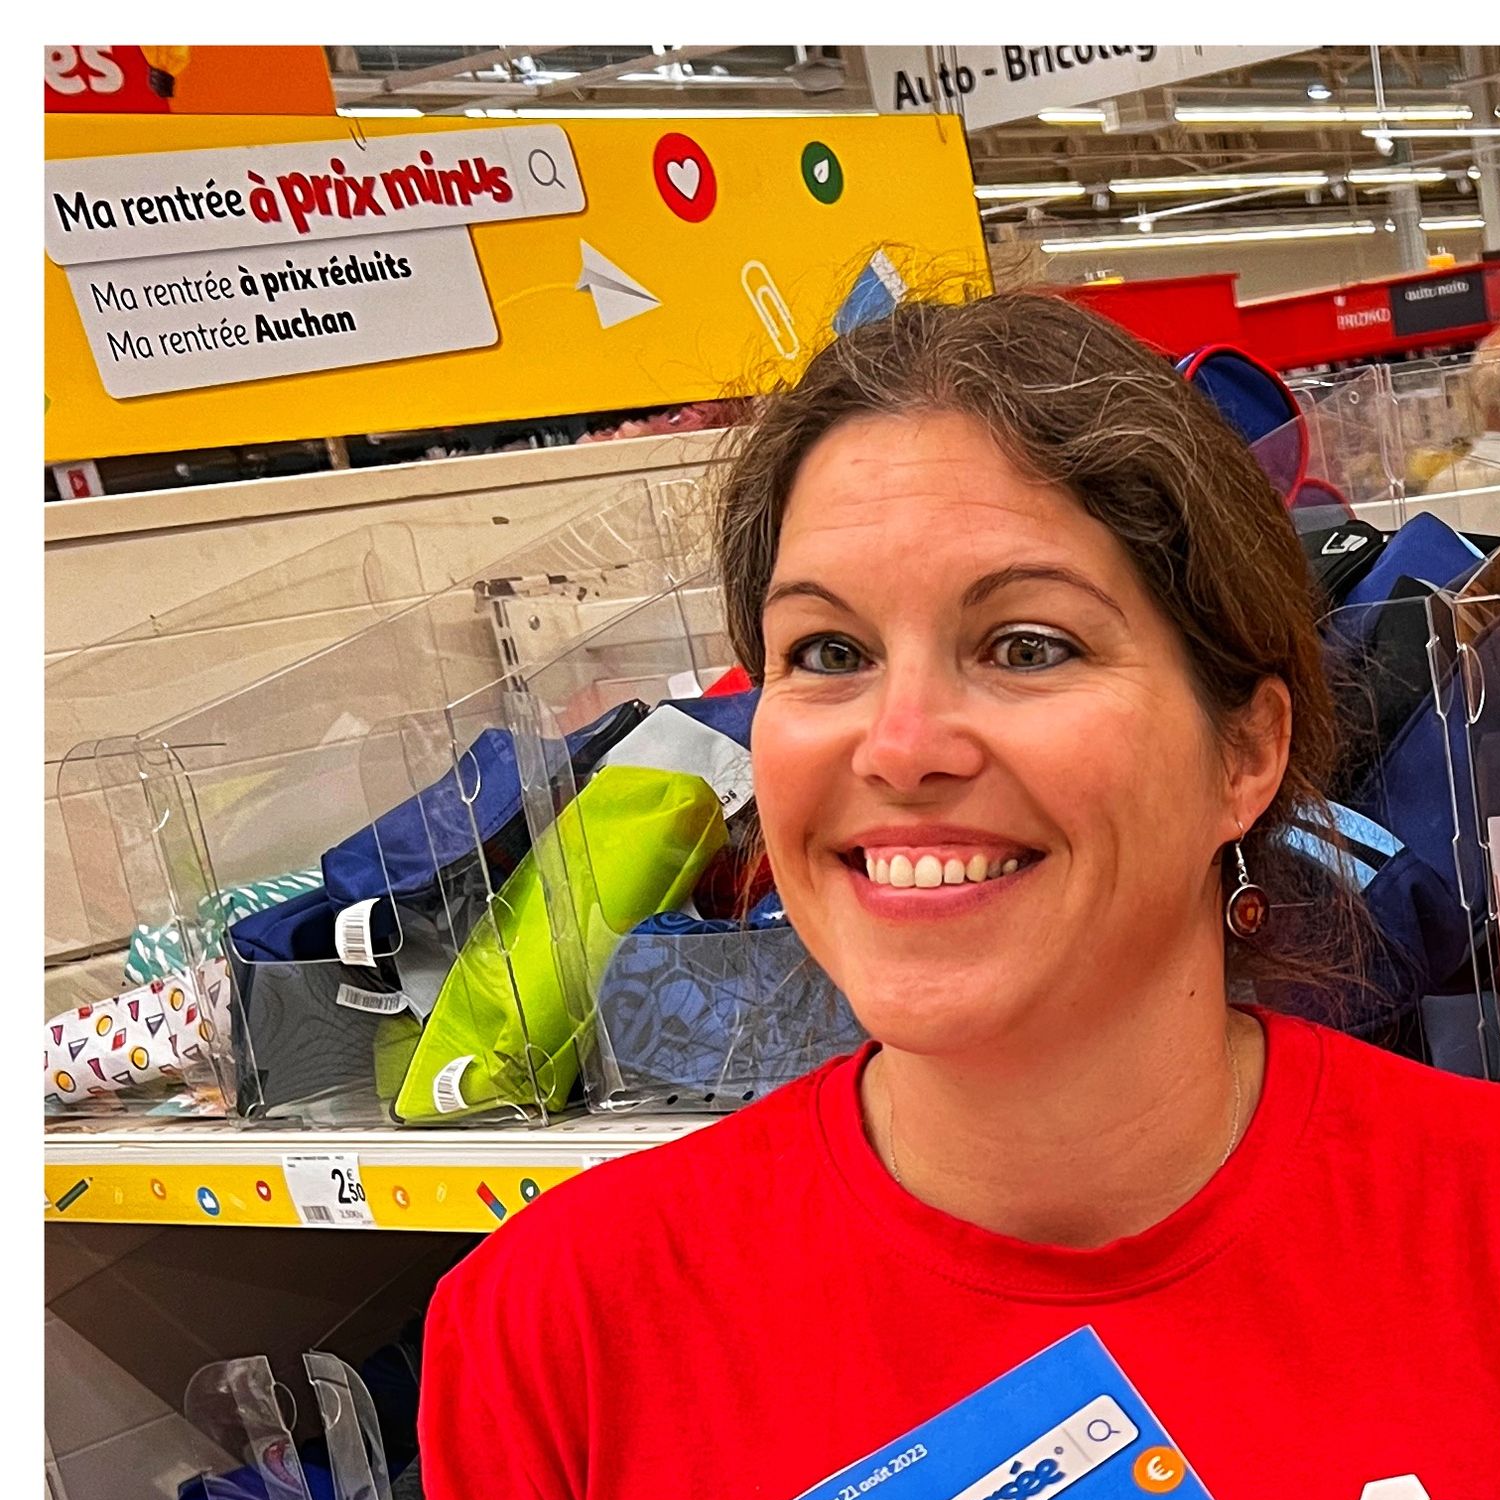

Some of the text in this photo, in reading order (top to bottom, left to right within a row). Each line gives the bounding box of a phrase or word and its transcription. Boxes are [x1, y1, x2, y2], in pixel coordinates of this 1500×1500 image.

[895, 65, 974, 111] Auto
[53, 150, 514, 234] Ma rentrée à prix minus
[90, 251, 413, 313] Ma rentrée à prix réduits
[106, 307, 357, 362] Ma rentrée Auchan
[331, 1169, 352, 1204] 2
[348, 1183, 366, 1202] 50
[858, 1466, 895, 1493] août
[889, 1442, 929, 1478] 2023
